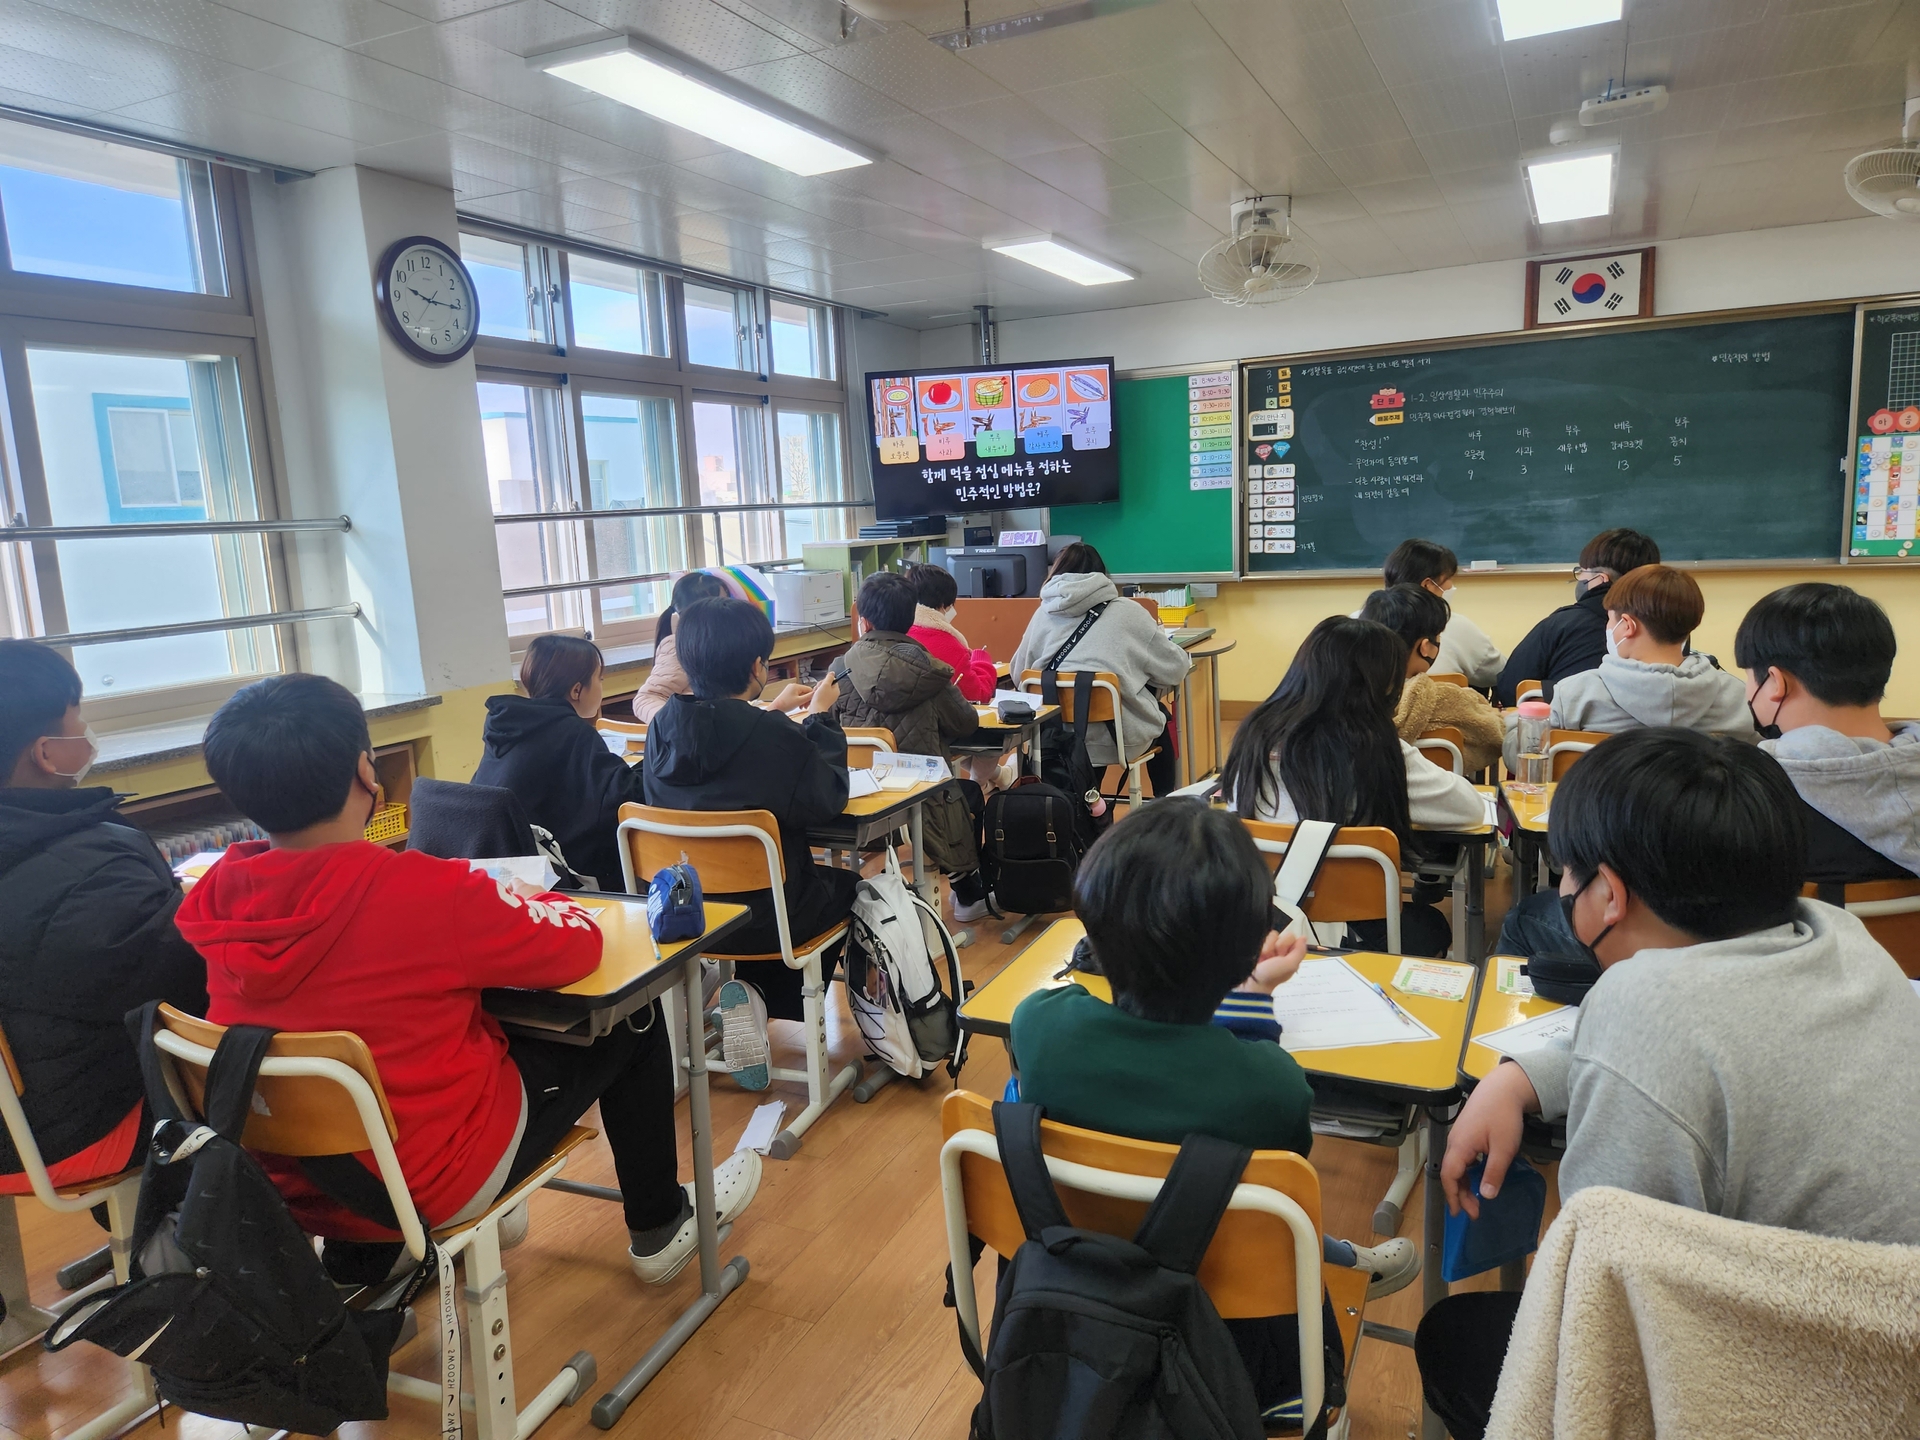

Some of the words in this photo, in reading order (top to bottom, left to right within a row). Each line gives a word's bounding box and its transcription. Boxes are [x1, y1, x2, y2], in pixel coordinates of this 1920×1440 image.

[406, 259, 415, 272] 11
[421, 256, 431, 269] 12
[396, 270, 407, 283] 10
[439, 264, 443, 276] 1
[449, 279, 455, 291] 2
[393, 290, 401, 302] 9
[455, 299, 462, 310] 3
[402, 311, 410, 324] 8
[453, 318, 459, 330] 4
[430, 333, 437, 345] 6
[444, 329, 451, 342] 5
[1719, 352, 1748, 363] 민주적인
[1751, 351, 1770, 362] 방법
[1266, 370, 1272, 379] 3
[1266, 384, 1273, 393] 15
[1430, 389, 1470, 401] 일상생활과
[1473, 387, 1504, 399] 민주주의
[1409, 412, 1432, 422] 민주적
[1268, 425, 1275, 433] 14
[1468, 429, 1482, 441] 바루
[1516, 427, 1531, 438] 비루
[1565, 425, 1581, 436] 부루
[1613, 420, 1633, 434] 베루
[1674, 416, 1690, 429] 보루
[938, 448, 952, 456] 사과
[1515, 446, 1534, 456] 사과
[1610, 438, 1643, 450] 감자크로켓
[1669, 436, 1687, 447] 꽁치
[921, 467, 947, 484] 함께
[950, 465, 972, 481] 먹을
[975, 463, 999, 480] 점심
[1001, 461, 1035, 477] 메뉴를
[1038, 459, 1072, 476] 정하는
[1467, 469, 1474, 480] 9
[1520, 464, 1528, 474] 3
[1564, 463, 1574, 474] 14
[1617, 459, 1630, 471] 13
[1673, 455, 1682, 466] 5
[1402, 474, 1424, 483] 의견과
[956, 484, 1001, 502] 민주적인
[1003, 482, 1041, 499] 방법은?
[1055, 643, 1072, 662] SWOOSH
[444, 1284, 453, 1325] SWOOSH
[447, 1349, 455, 1389] SWOOSH
